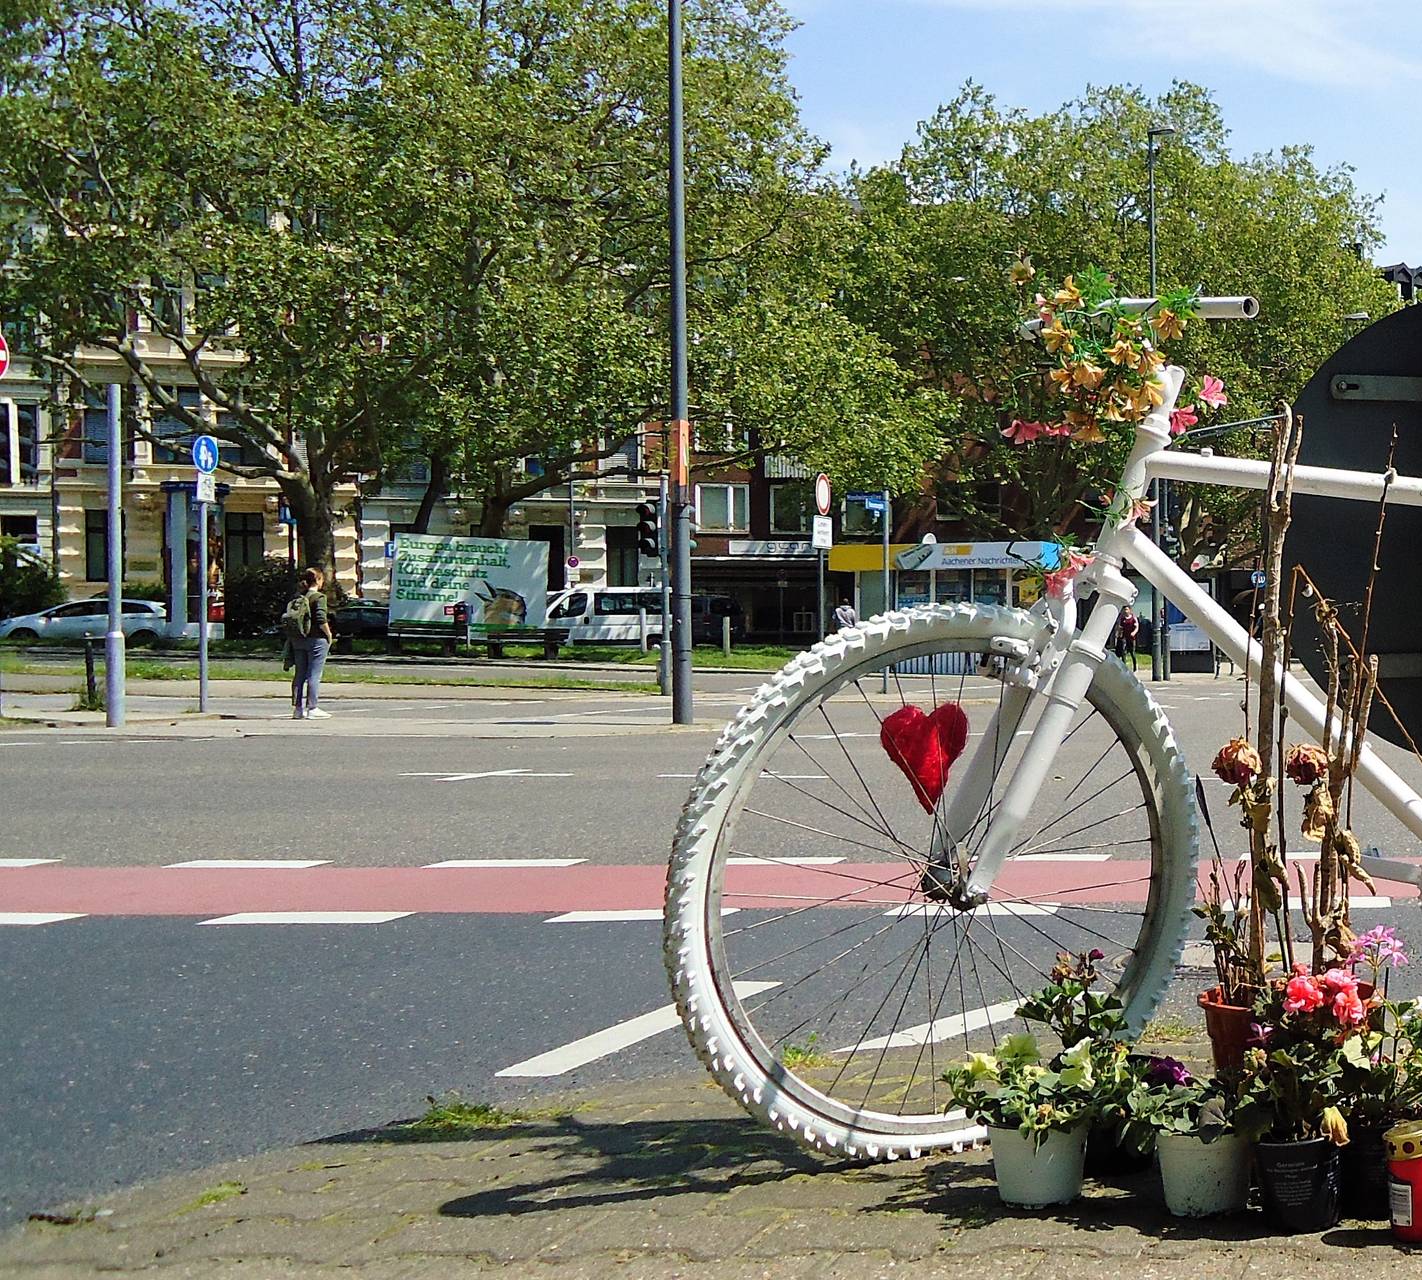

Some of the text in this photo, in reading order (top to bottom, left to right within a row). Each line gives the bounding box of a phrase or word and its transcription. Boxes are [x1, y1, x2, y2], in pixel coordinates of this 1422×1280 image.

[400, 537, 509, 555] Europa braucht
[398, 550, 511, 569] Zusammenhalt,
[941, 556, 977, 566] Aachener
[397, 563, 488, 579] Klimaschutz
[397, 577, 470, 591] und deine
[395, 588, 459, 602] Stimme!
